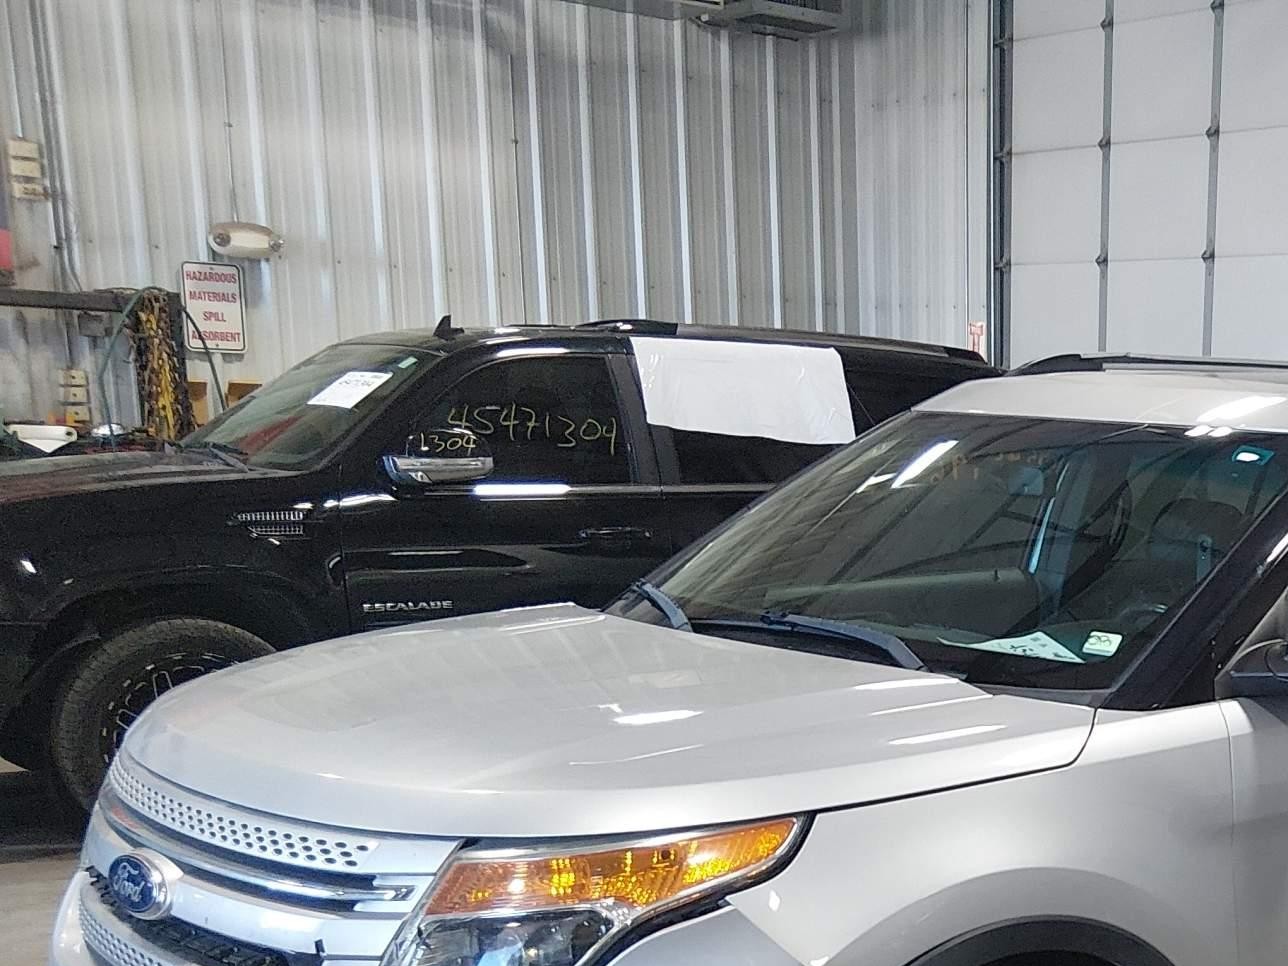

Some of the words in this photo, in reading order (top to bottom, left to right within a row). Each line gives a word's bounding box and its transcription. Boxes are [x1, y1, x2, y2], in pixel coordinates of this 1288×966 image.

[185, 270, 237, 284] HAZARDOUS
[189, 290, 237, 303] MATERIALS
[203, 311, 226, 322] SPILL
[448, 402, 617, 456] 45471304
[362, 600, 453, 613] ESCALADE
[113, 862, 145, 902] Ford
